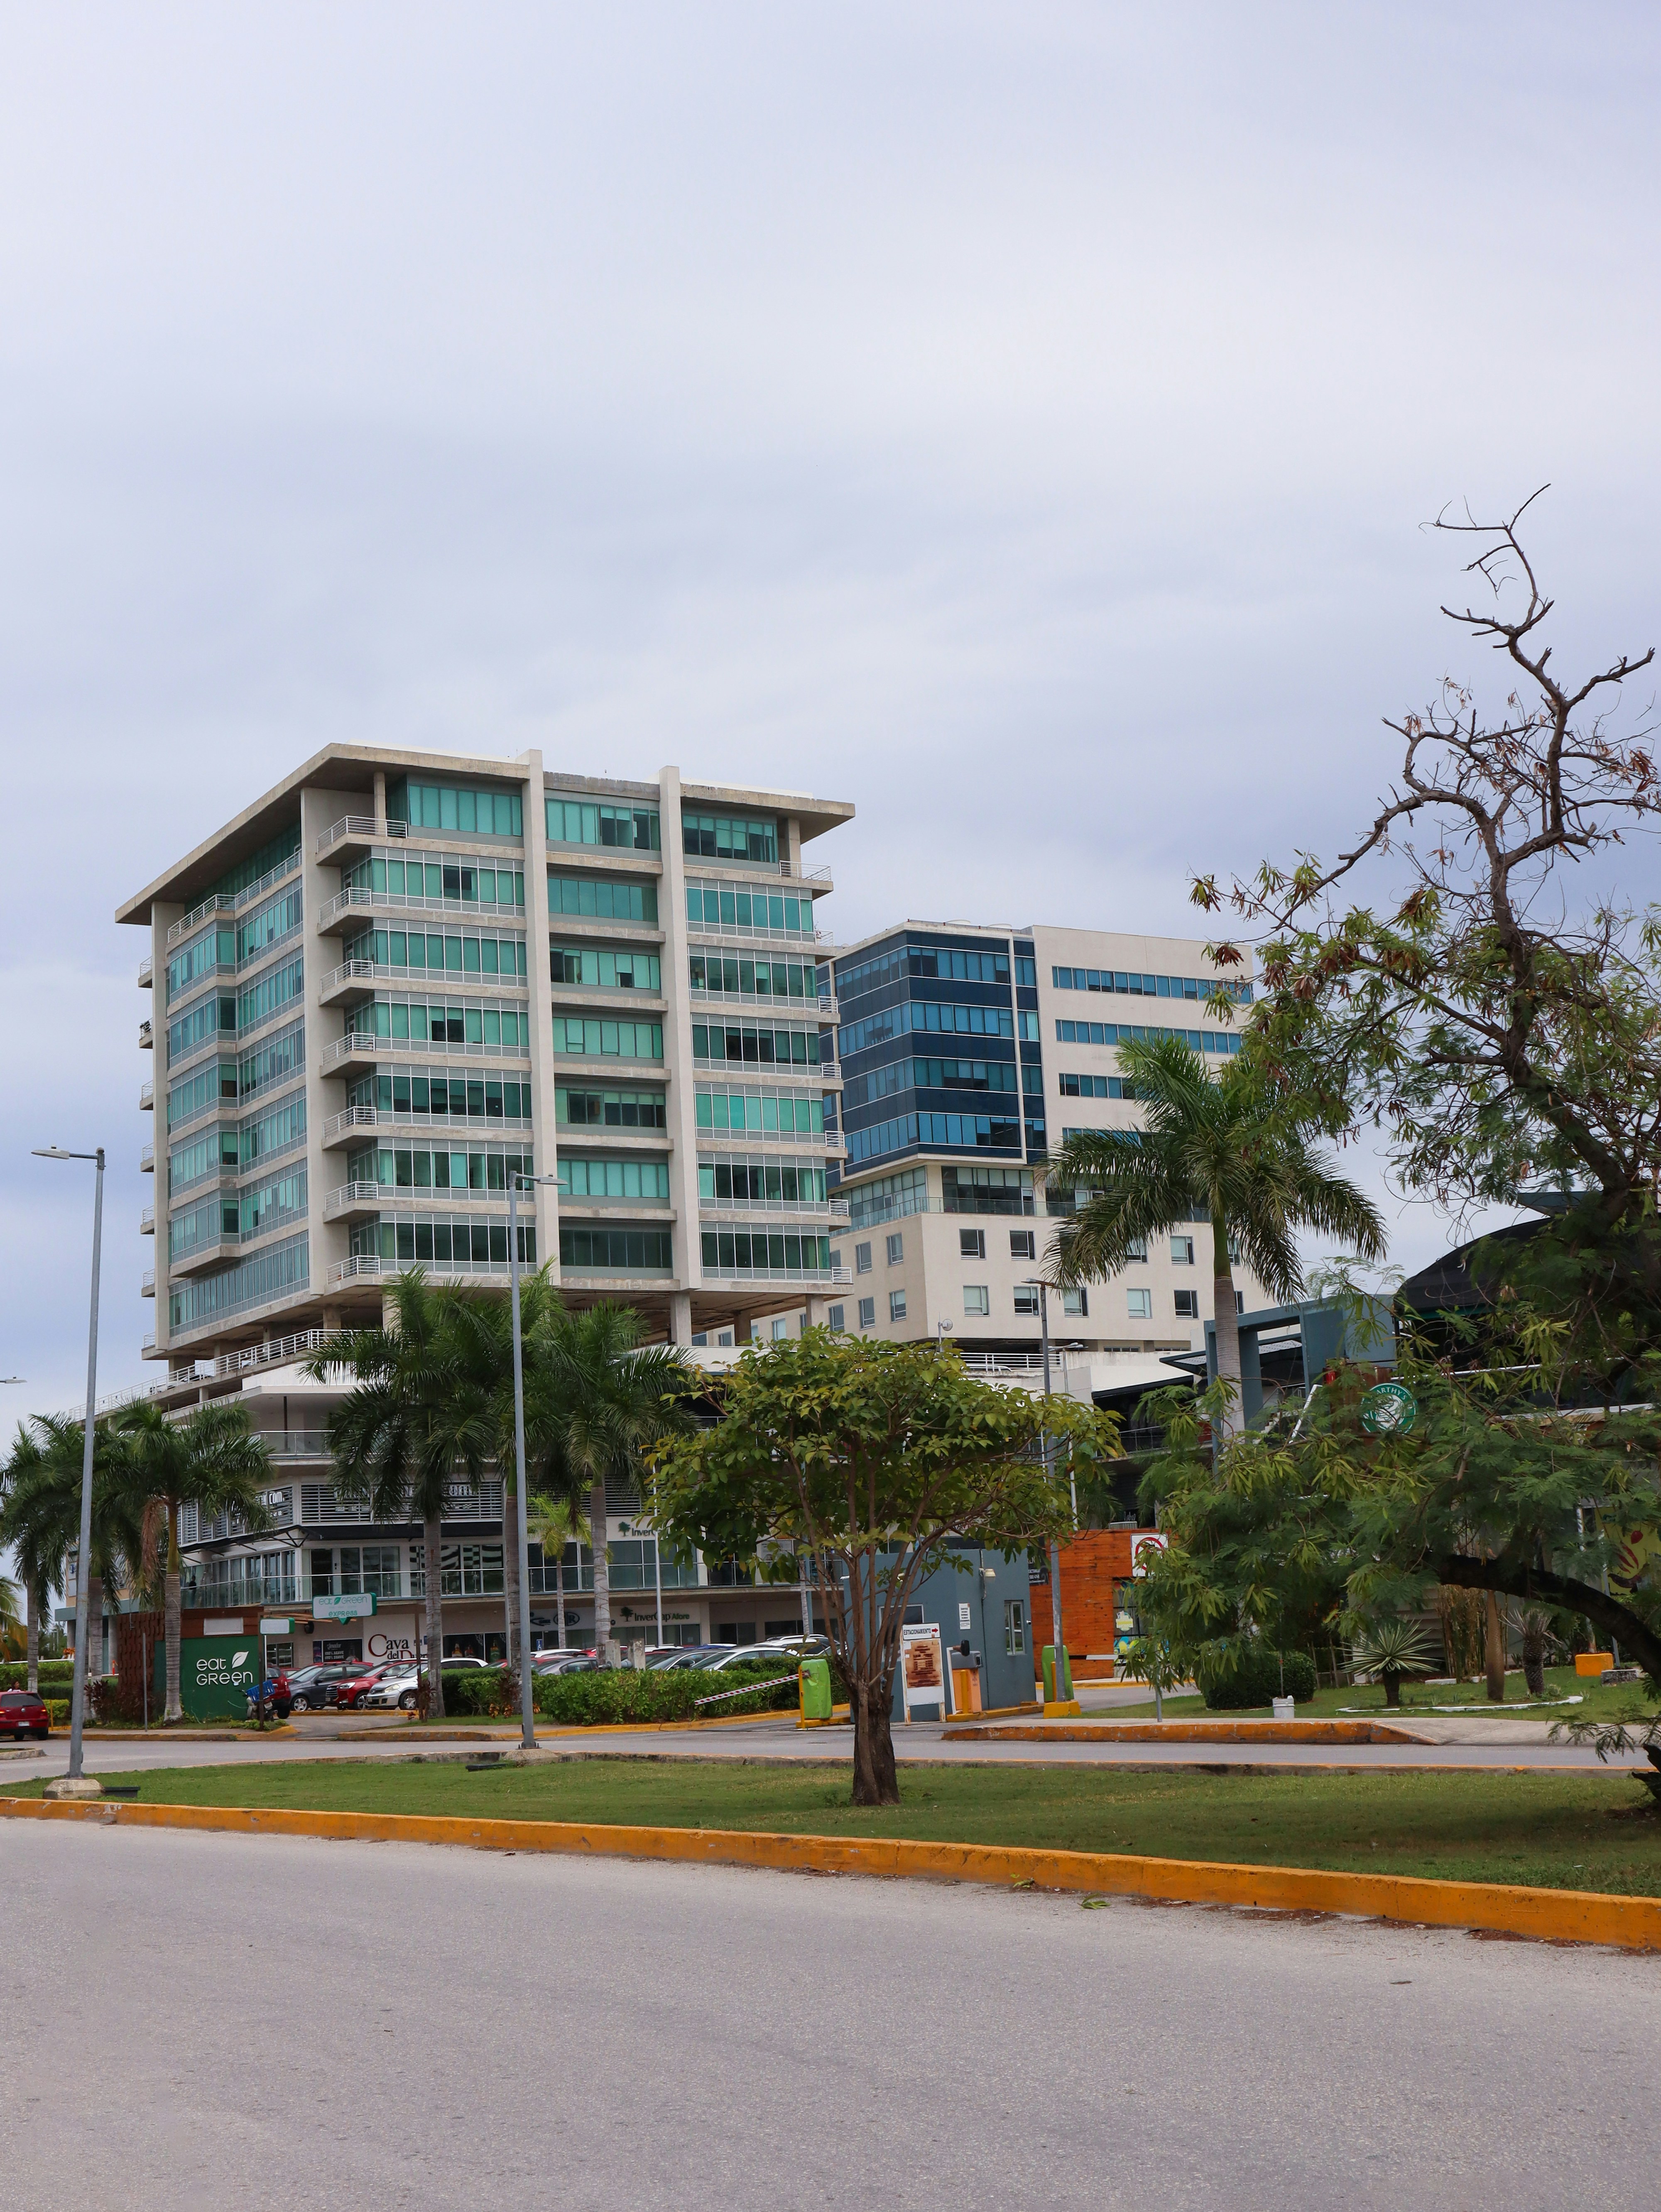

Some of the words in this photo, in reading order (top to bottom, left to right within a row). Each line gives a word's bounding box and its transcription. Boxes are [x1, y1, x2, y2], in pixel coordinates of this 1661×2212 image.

[368, 1634, 409, 1657] Cava
[387, 1650, 399, 1659] del
[196, 1658, 226, 1671] eat
